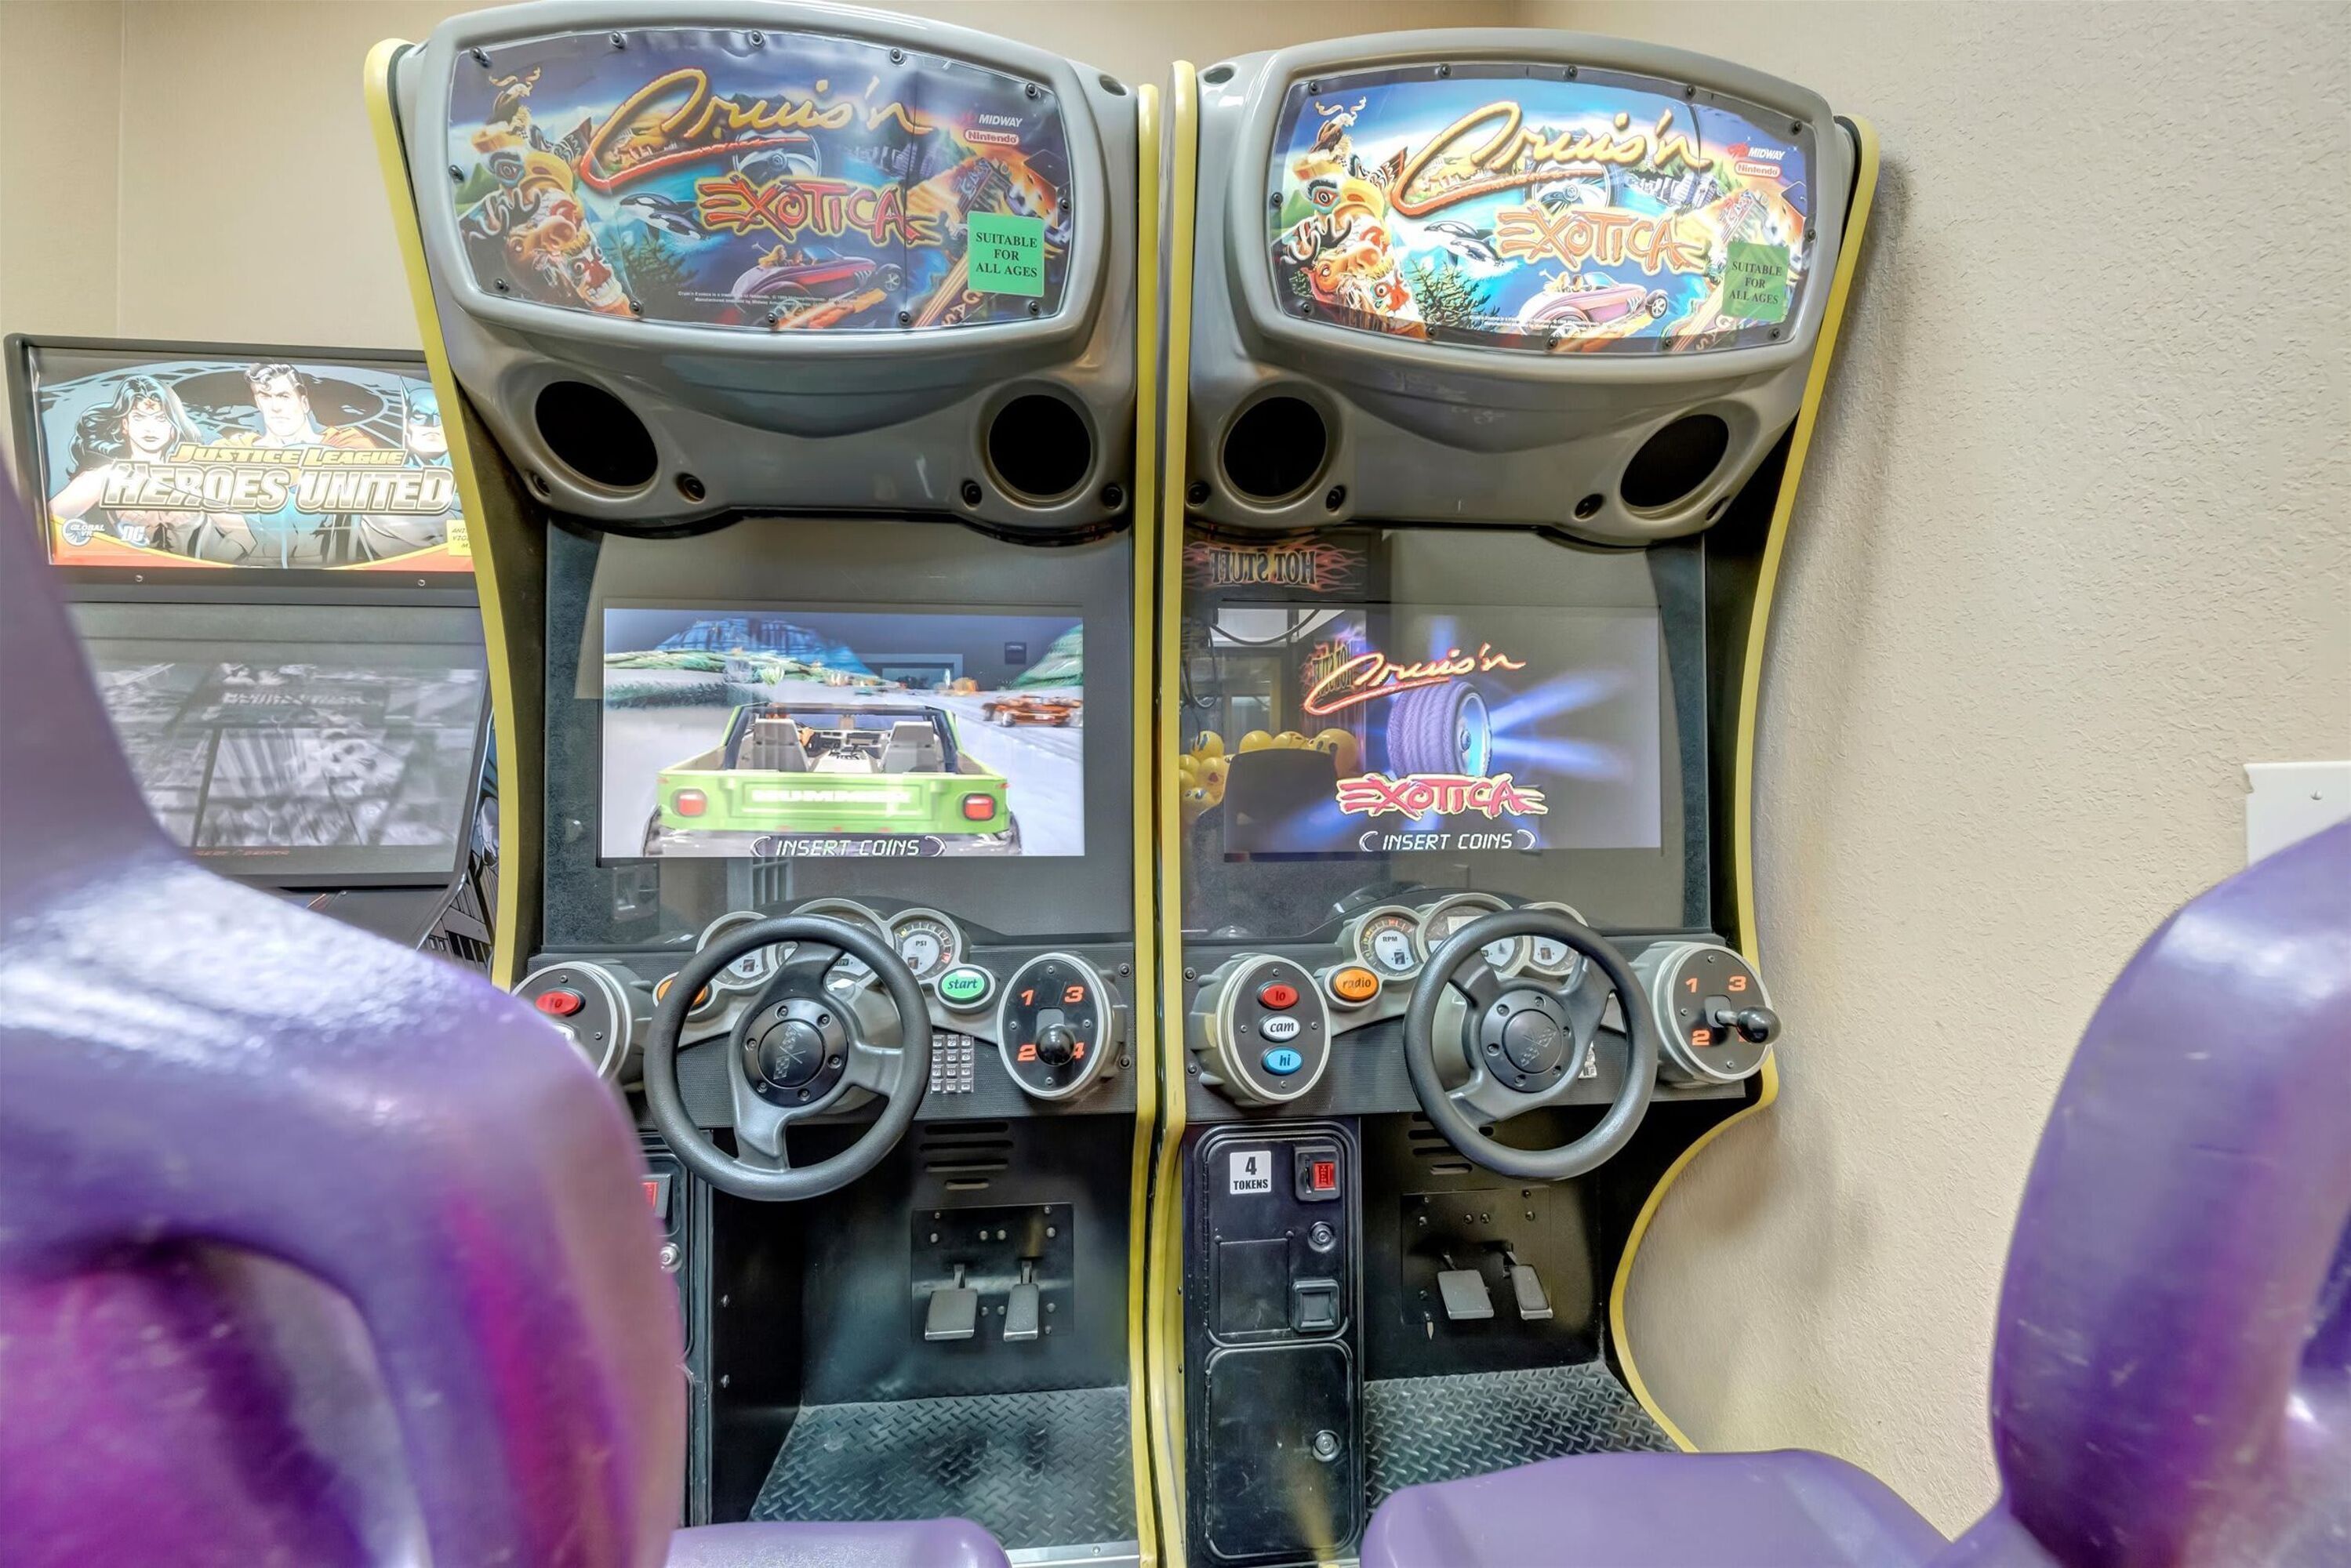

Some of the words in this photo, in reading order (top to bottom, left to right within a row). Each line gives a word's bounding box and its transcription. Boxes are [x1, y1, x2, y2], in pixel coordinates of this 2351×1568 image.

[979, 114, 1023, 127] MIDWAY
[580, 67, 936, 194] Cruis'n
[968, 131, 1017, 143] Nintendo
[1389, 101, 1714, 217] Cruis'n
[1748, 147, 1786, 161] MIDWAY
[1738, 163, 1779, 176] Nintendo
[696, 175, 946, 248] EXOTICA
[976, 232, 1037, 248] SUITABLE
[1496, 206, 1706, 274] EXOTICA
[994, 249, 1019, 261] FOR
[976, 263, 1001, 274] ALL
[1005, 265, 1037, 278] AGES
[1731, 261, 1782, 277] SUITABLE
[1745, 277, 1766, 289] FOR
[1729, 291, 1750, 302] ALL
[1752, 293, 1779, 304] AGES
[173, 443, 300, 466] JUSTICE
[302, 447, 407, 468] LEAGUE
[100, 459, 291, 511] HEROES
[296, 466, 455, 516] UNITED
[121, 526, 147, 542] DC
[1303, 643, 1526, 715] Cruis'n
[1336, 773, 1549, 820] EXOTICA
[775, 840, 851, 856] INSERT
[859, 840, 920, 856] COINS
[1383, 833, 1451, 851] INSERT
[1458, 833, 1512, 850] COINS
[947, 978, 978, 989] start
[1343, 977, 1372, 989] radio
[1685, 978, 1698, 993] 1
[1728, 976, 1746, 991] 3
[1021, 989, 1034, 1005] 1
[1064, 986, 1084, 1003] 3
[1275, 990, 1286, 1001] lo
[1270, 1022, 1295, 1033] cam
[1691, 1030, 1710, 1045] 2
[1018, 1044, 1036, 1061] 2
[1279, 1054, 1291, 1066] hi
[1245, 1156, 1257, 1175] 4
[1234, 1178, 1269, 1190] TOKENS
